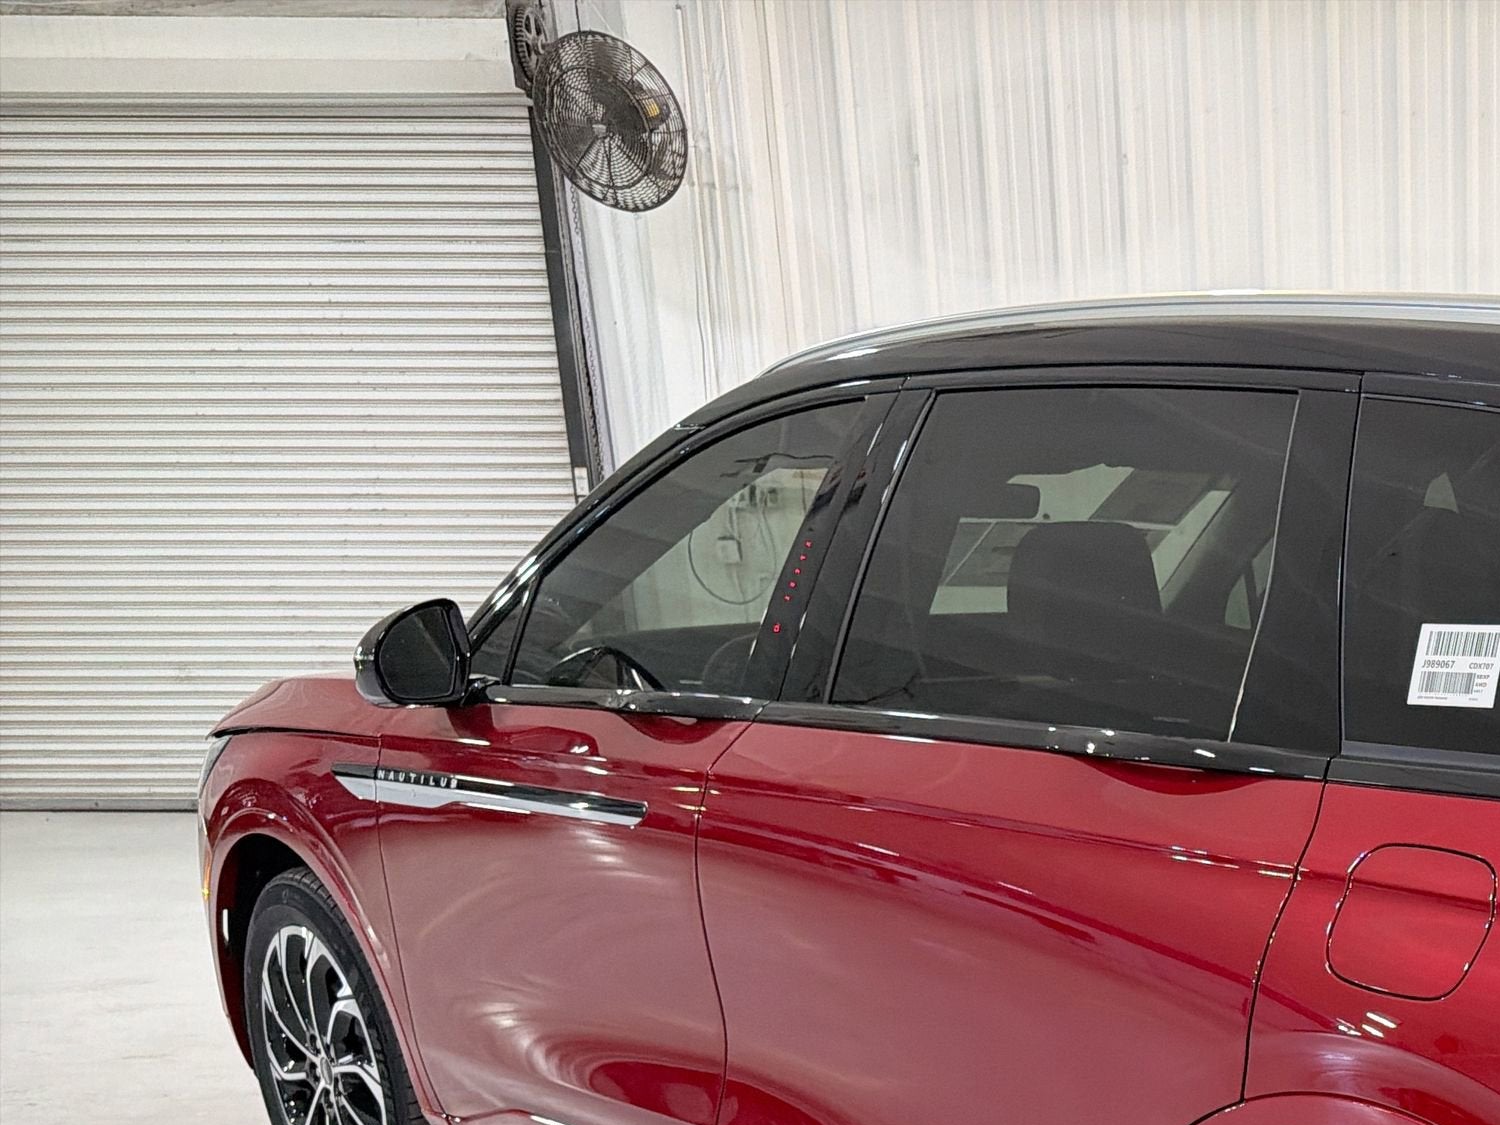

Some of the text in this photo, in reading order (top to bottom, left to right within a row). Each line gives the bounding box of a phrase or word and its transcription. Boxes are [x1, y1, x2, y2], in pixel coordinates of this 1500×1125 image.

[1421, 659, 1494, 670] J989067 CDX707
[377, 769, 458, 789] NAUTILUS
